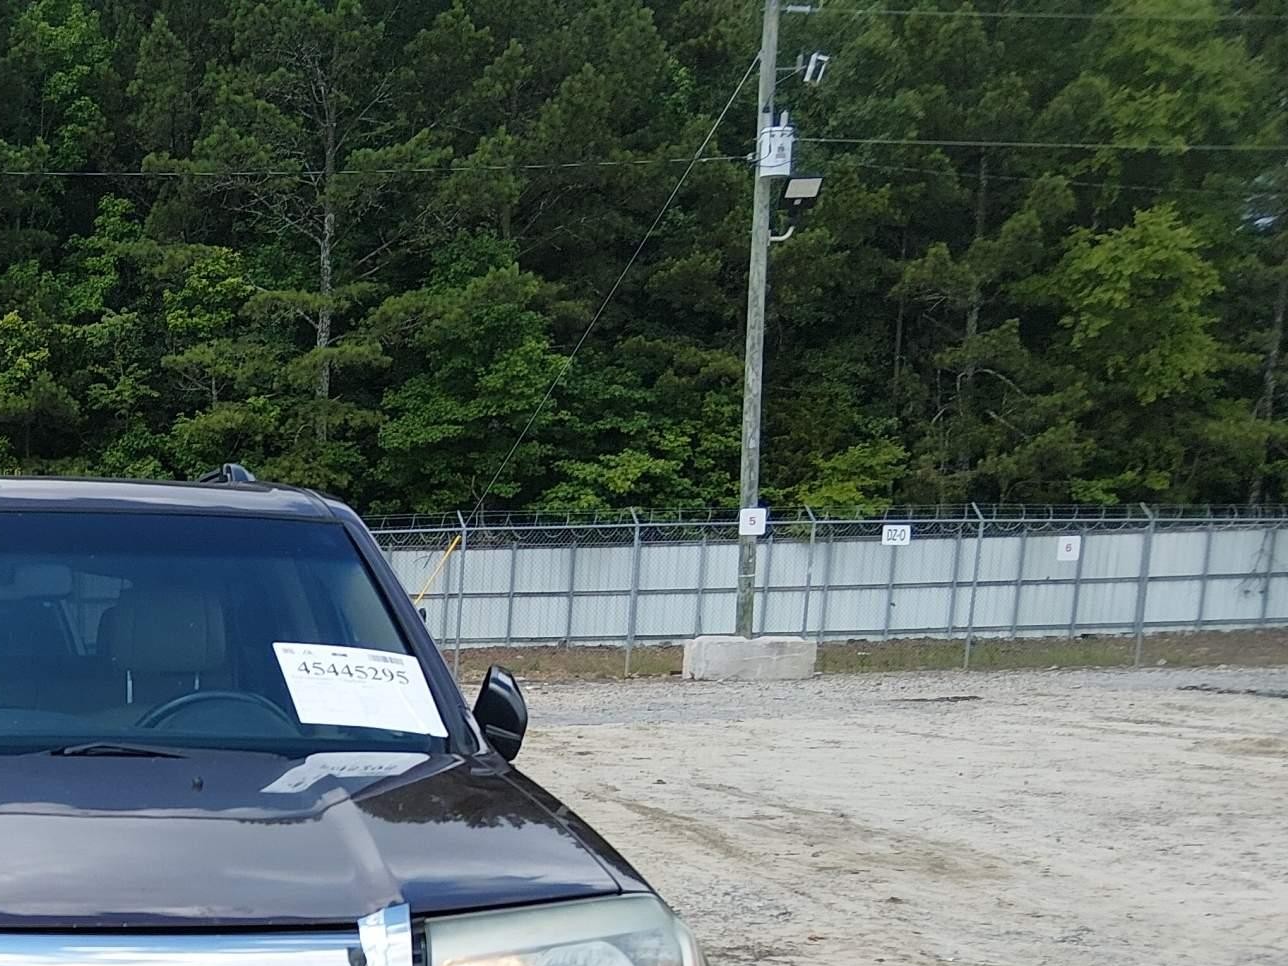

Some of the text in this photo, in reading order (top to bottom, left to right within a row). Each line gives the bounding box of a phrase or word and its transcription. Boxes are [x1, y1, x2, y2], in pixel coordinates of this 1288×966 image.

[749, 516, 757, 526] 5
[1065, 543, 1073, 553] 6
[297, 661, 409, 685] 45445295
